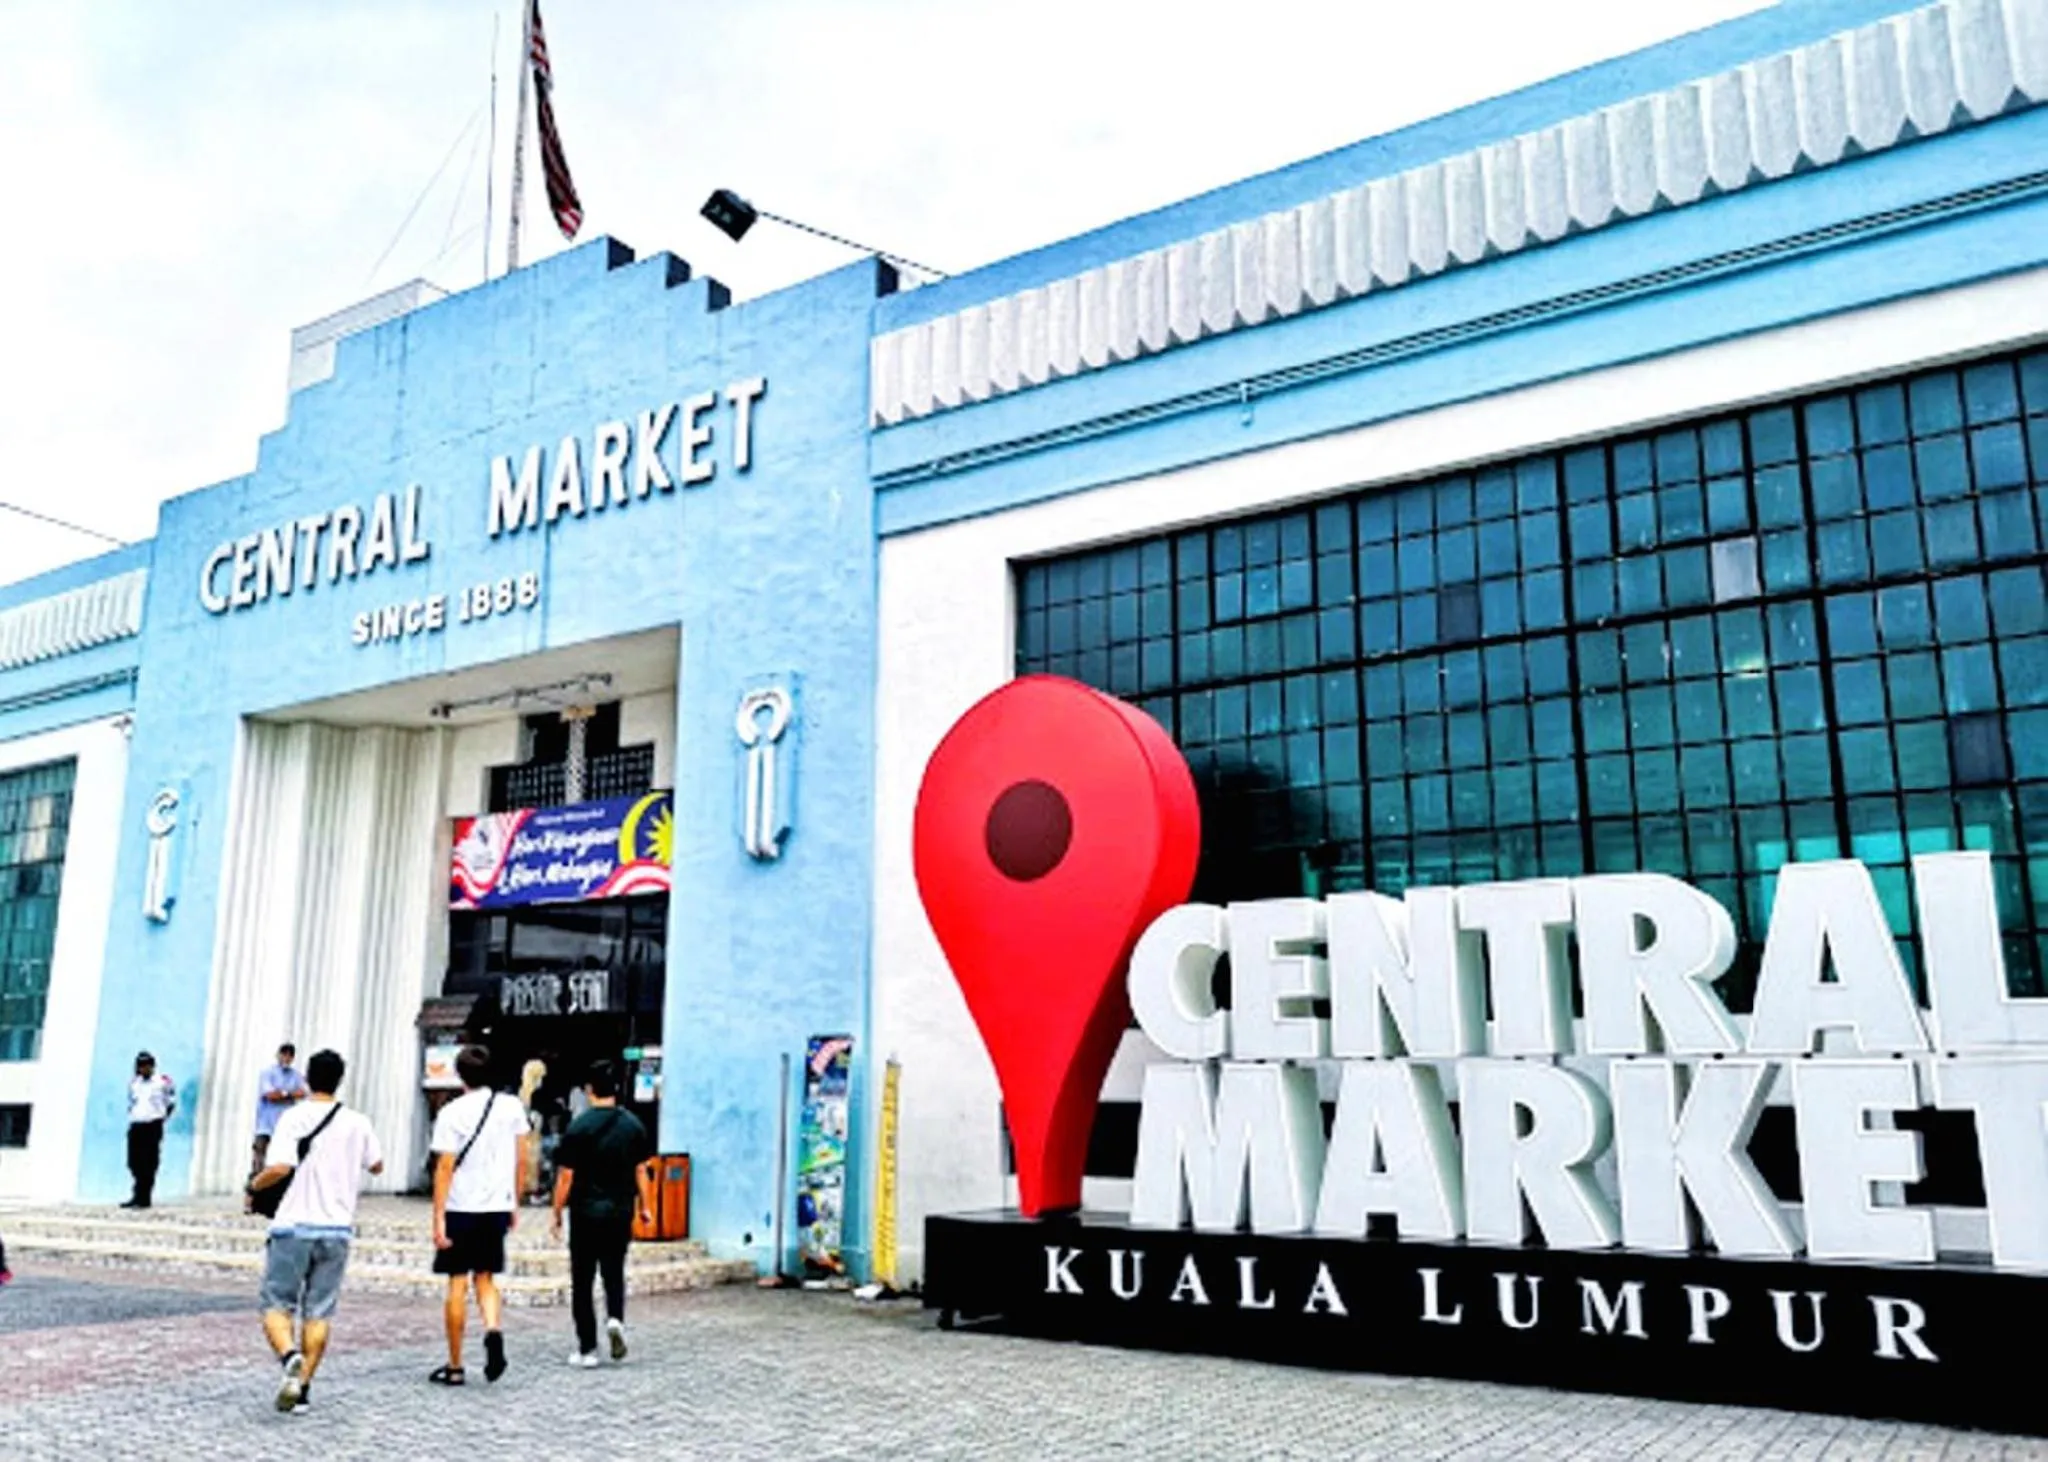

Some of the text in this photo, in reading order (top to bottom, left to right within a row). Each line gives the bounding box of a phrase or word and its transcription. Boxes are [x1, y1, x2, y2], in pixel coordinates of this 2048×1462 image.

[199, 377, 767, 614] CENTRAL MARKET
[351, 571, 540, 646] SINCE 1888
[1128, 850, 2048, 1058] CENTRAL
[1130, 1059, 2048, 1270] MARKET
[1044, 1245, 1940, 1364] KUALA LUMPUR
